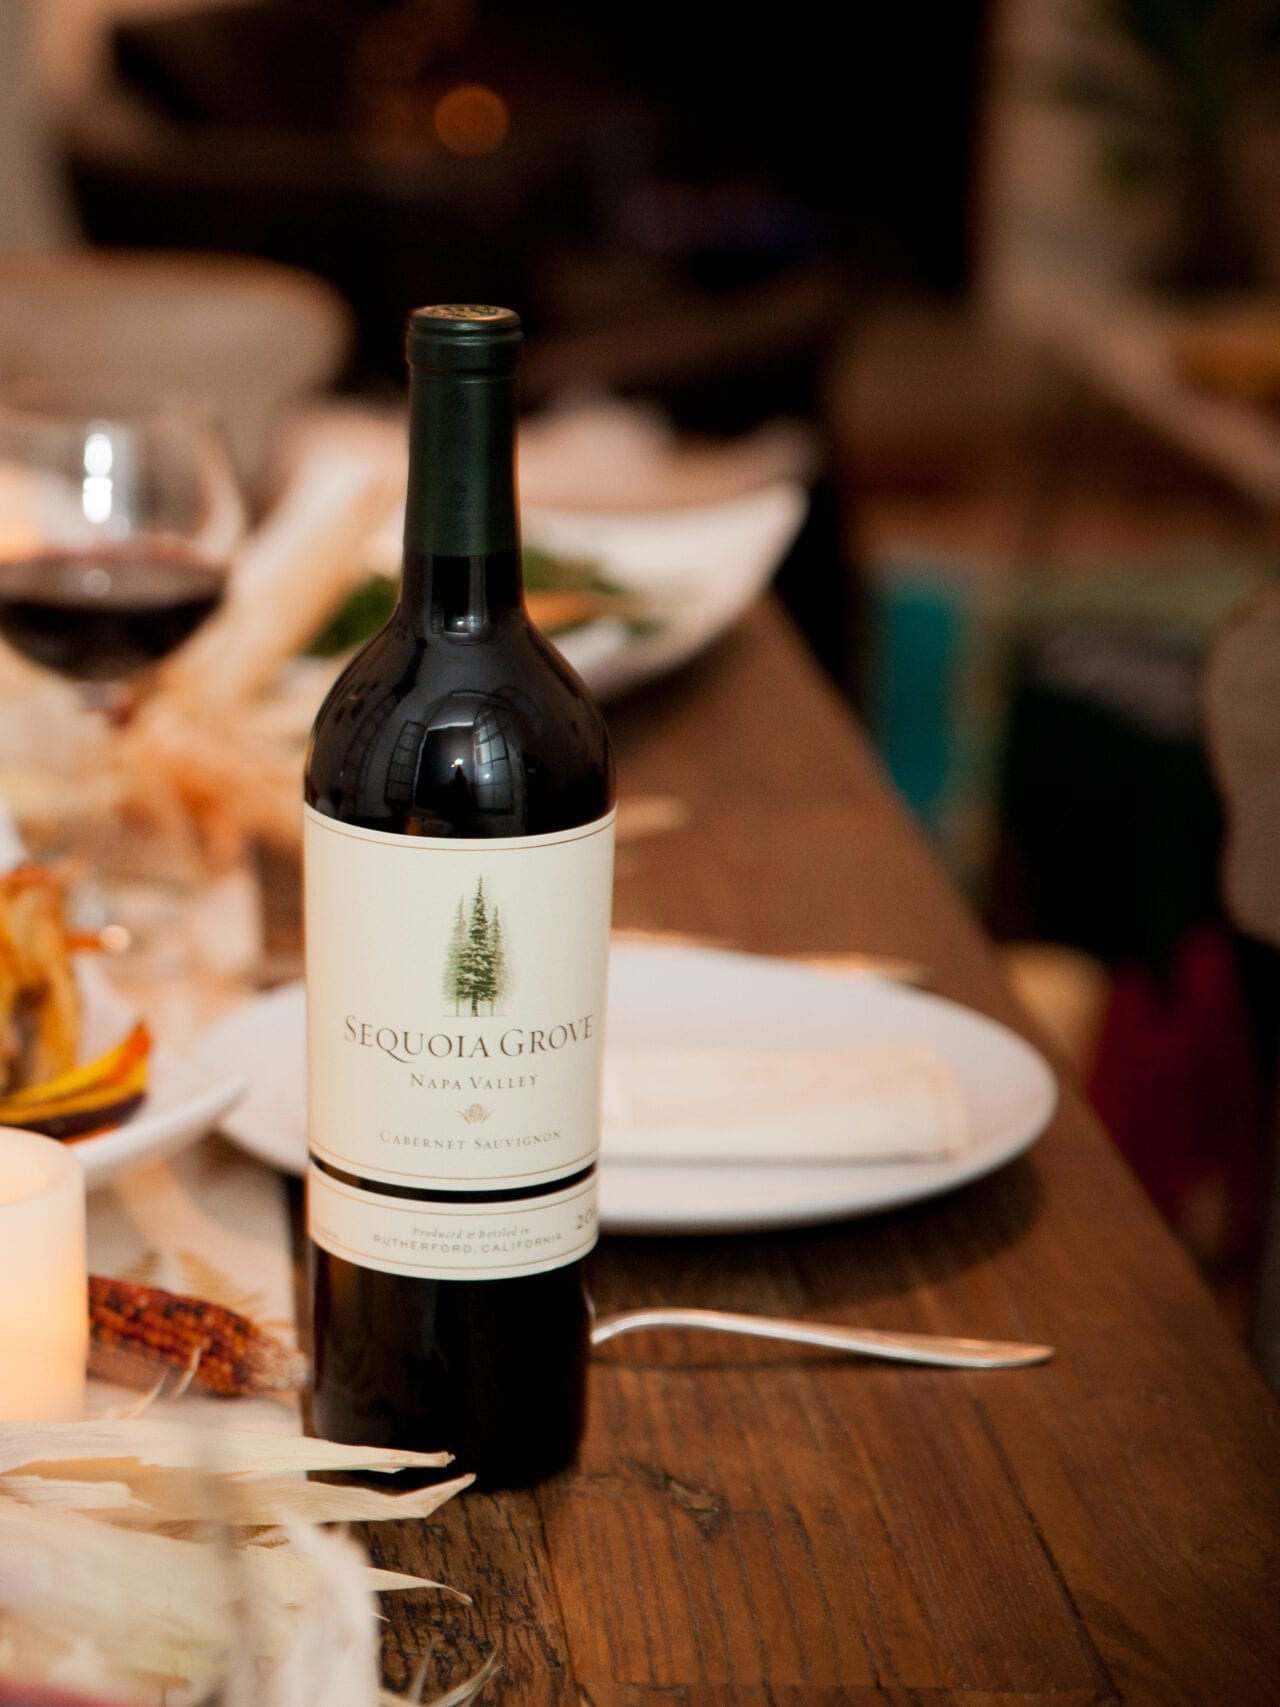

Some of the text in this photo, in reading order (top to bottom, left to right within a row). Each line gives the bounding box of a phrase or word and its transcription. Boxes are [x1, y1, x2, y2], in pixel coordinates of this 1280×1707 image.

[345, 1014, 593, 1063] SEQUOIA GROVE
[410, 1073, 538, 1090] NAPA VALLEY
[380, 1130, 561, 1150] CABERNET SAUVIGNON
[413, 1226, 463, 1239] Produced
[479, 1226, 517, 1239] Bottled
[481, 1232, 563, 1252] CALIFORNIA
